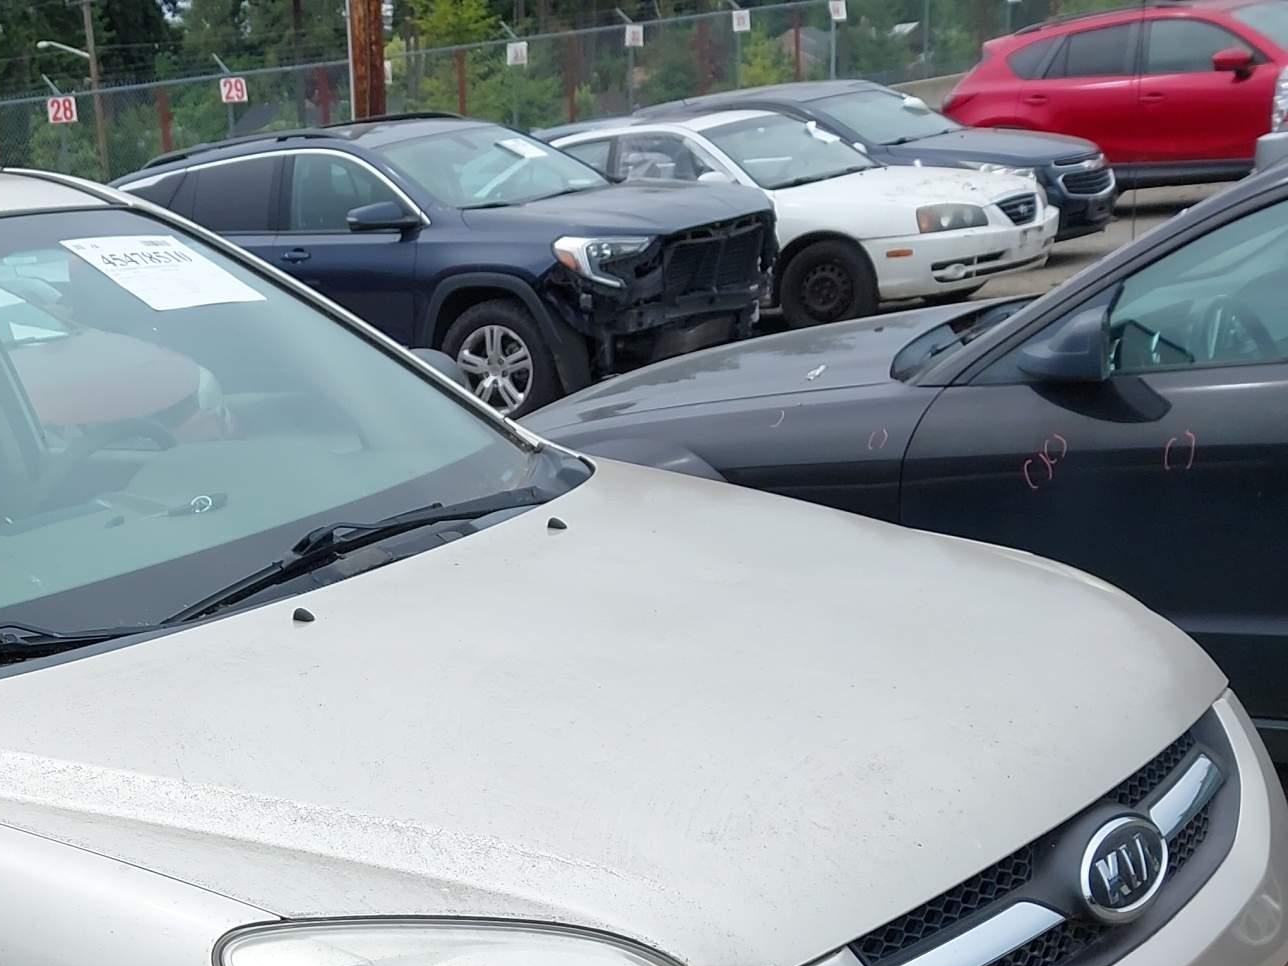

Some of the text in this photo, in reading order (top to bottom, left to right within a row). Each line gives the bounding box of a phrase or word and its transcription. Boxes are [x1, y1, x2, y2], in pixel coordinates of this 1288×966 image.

[223, 79, 244, 100] 29
[51, 98, 73, 121] 28
[99, 250, 193, 267] 45478510
[1095, 832, 1160, 905] KIA
